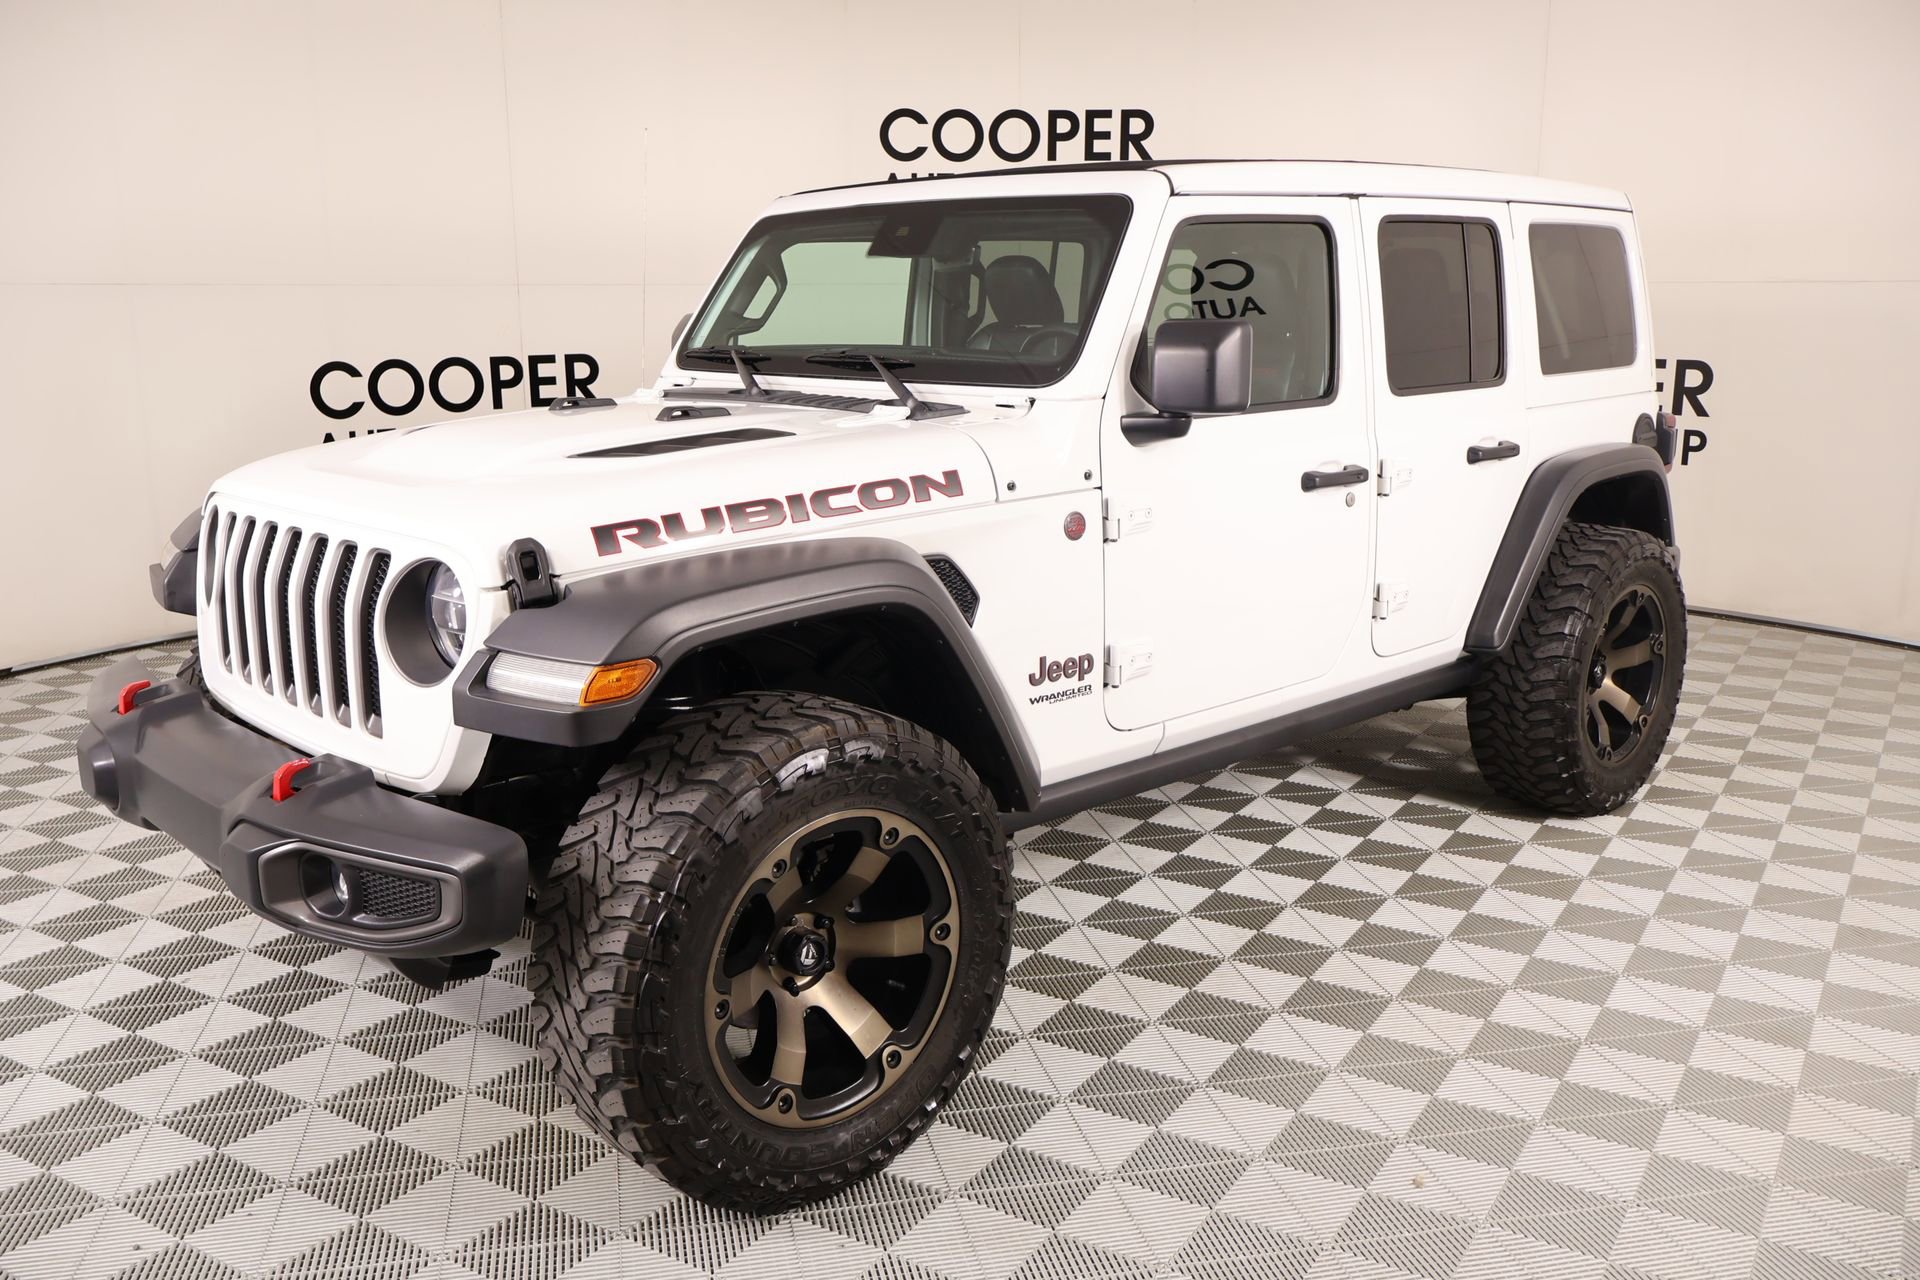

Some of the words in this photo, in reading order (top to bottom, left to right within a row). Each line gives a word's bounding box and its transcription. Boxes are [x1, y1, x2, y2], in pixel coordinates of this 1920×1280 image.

[879, 108, 1155, 162] COOPER
[310, 353, 600, 420] COOPER
[1675, 428, 1708, 466] P
[590, 469, 964, 557] RUBICON
[1028, 653, 1094, 687] Jeep
[1029, 684, 1092, 705] WRANGLER
